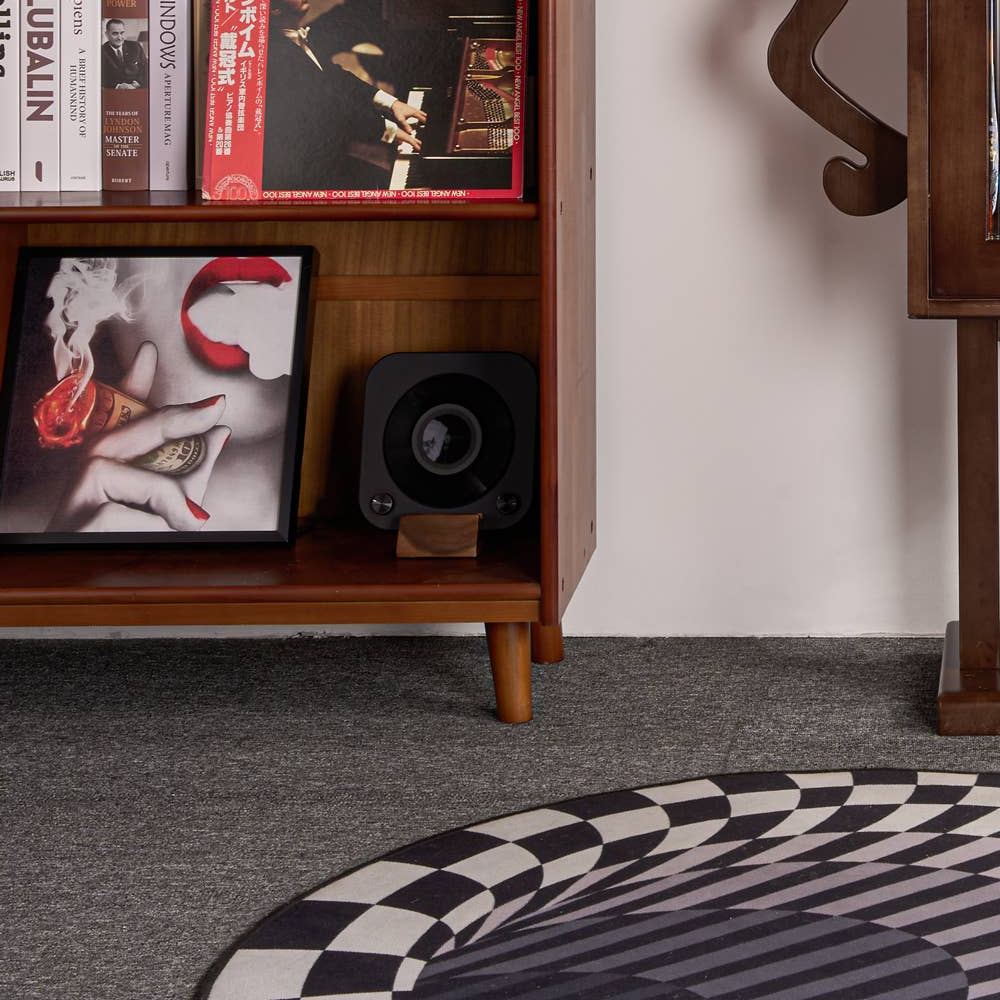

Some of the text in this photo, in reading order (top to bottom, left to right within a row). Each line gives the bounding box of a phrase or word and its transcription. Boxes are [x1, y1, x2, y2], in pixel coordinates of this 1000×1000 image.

[106, 0, 137, 8] POWER
[104, 118, 140, 126] LYNDON
[79, 126, 86, 138] OF
[105, 135, 139, 143] MASTER
[106, 149, 138, 157] SENATE
